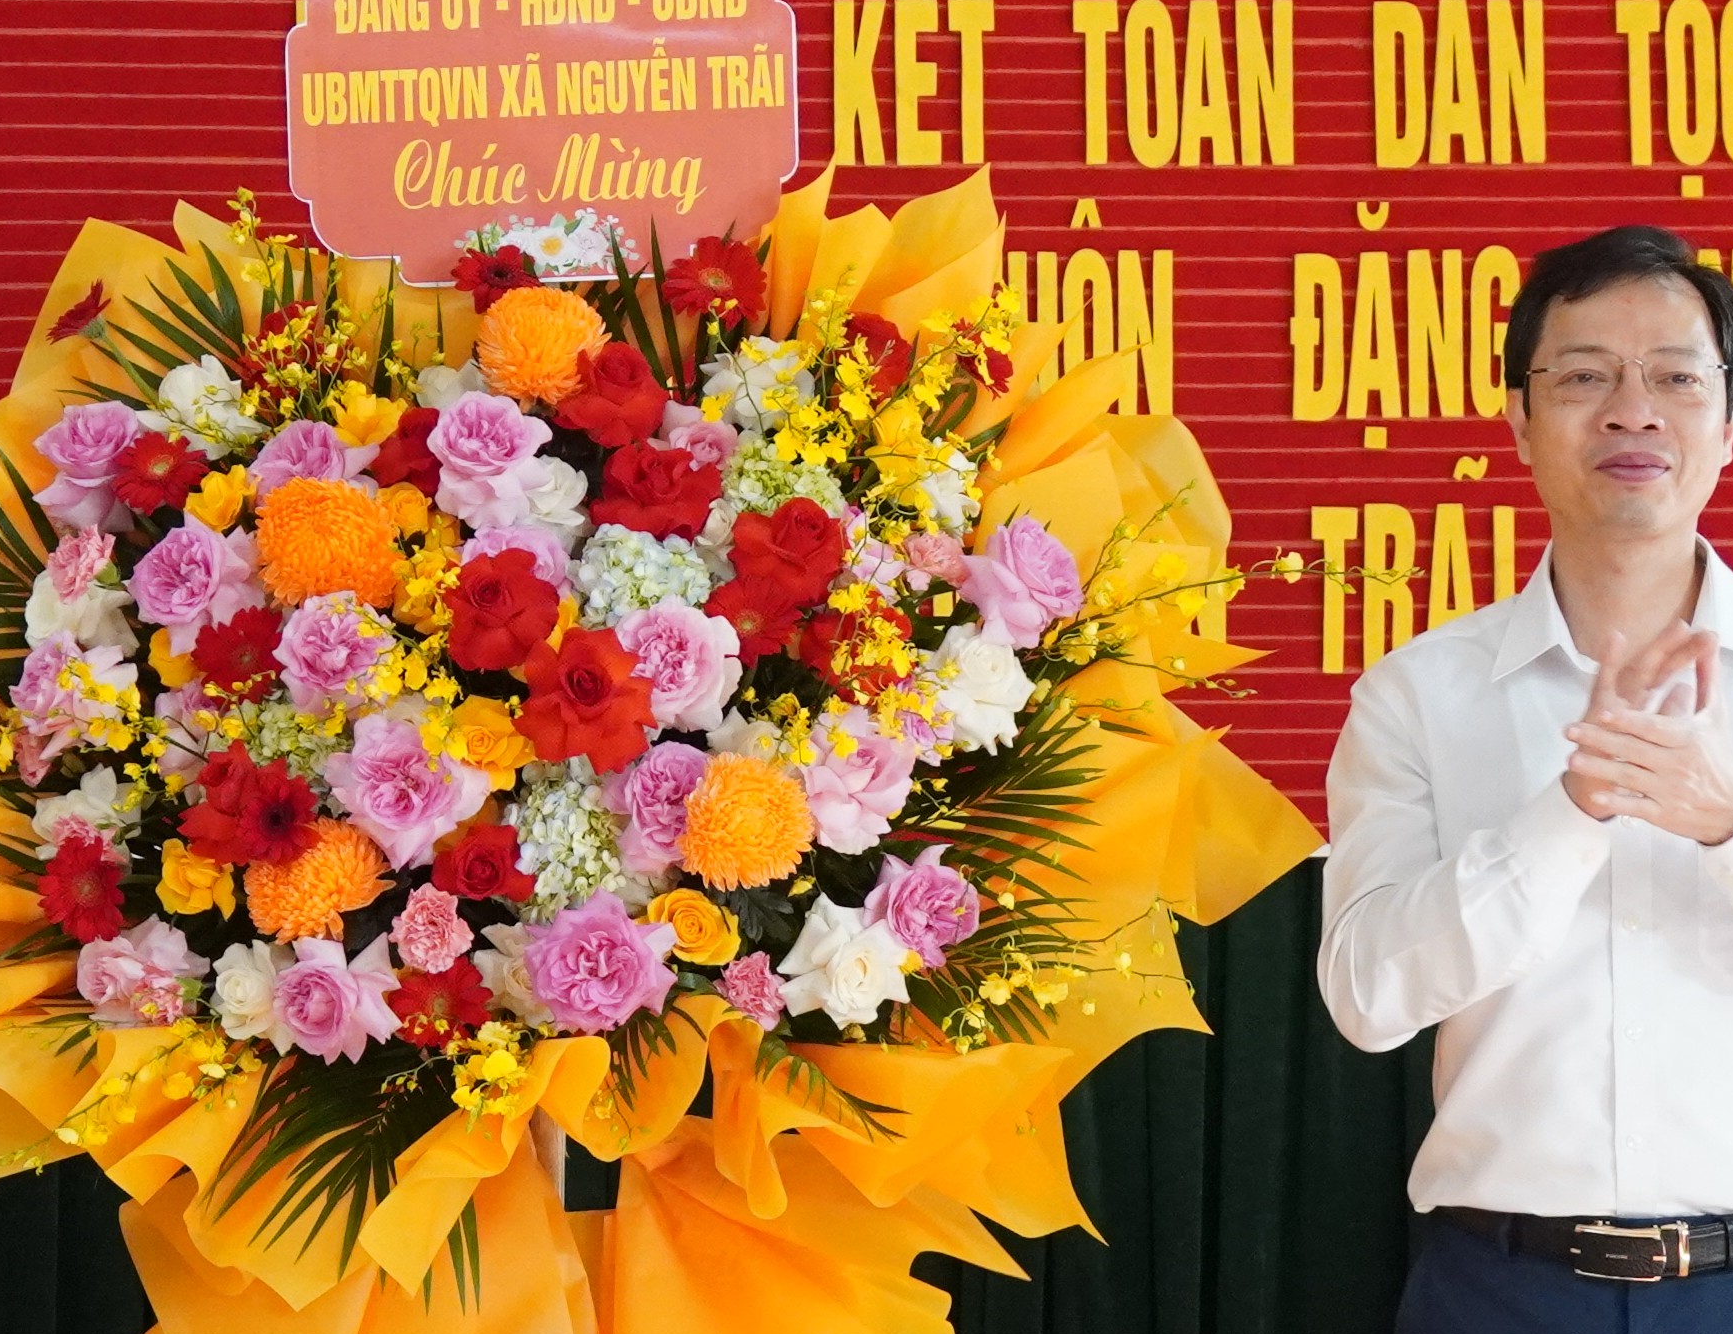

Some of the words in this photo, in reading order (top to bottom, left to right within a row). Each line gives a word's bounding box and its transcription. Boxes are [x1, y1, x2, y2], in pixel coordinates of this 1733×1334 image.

[496, 0, 510, 12] -
[302, 66, 488, 127] UBMTTQVN
[499, 53, 546, 118] XÃ
[557, 37, 697, 117] NGUYỄN
[707, 43, 785, 110] TRÃI
[394, 138, 526, 209] Chúc
[536, 132, 708, 215] Mừng
[1005, 198, 1174, 415] HÔN
[1289, 201, 1521, 450] ĐẶNG
